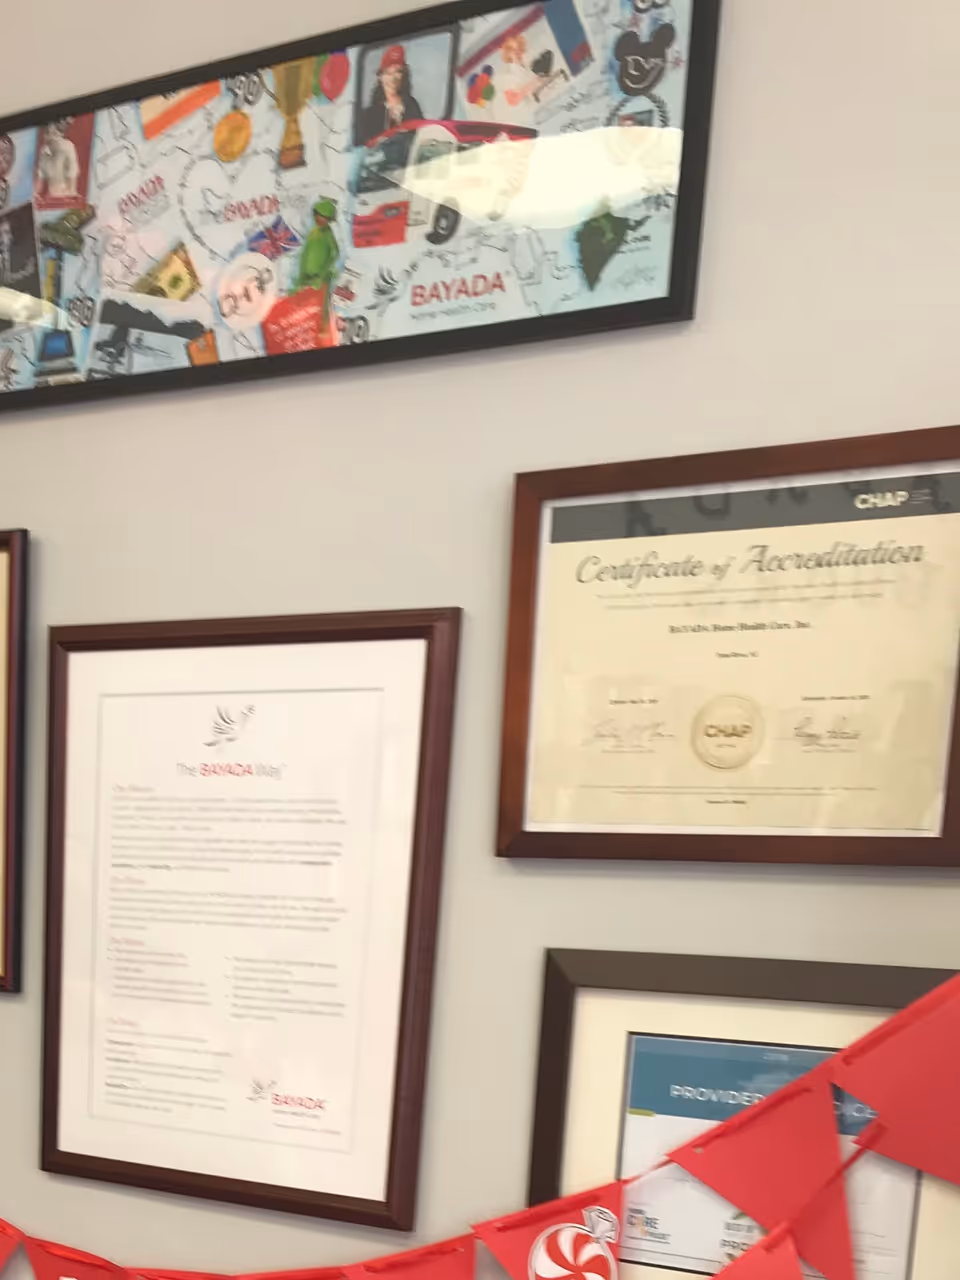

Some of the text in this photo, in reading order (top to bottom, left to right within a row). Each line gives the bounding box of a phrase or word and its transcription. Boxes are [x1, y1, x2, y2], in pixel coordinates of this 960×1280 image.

[410, 271, 505, 307] BAYADA
[854, 491, 909, 509] CHAP
[575, 550, 705, 589] Certificate
[711, 556, 737, 580] of
[740, 540, 924, 574] Accreditation
[704, 723, 752, 739] CHAP
